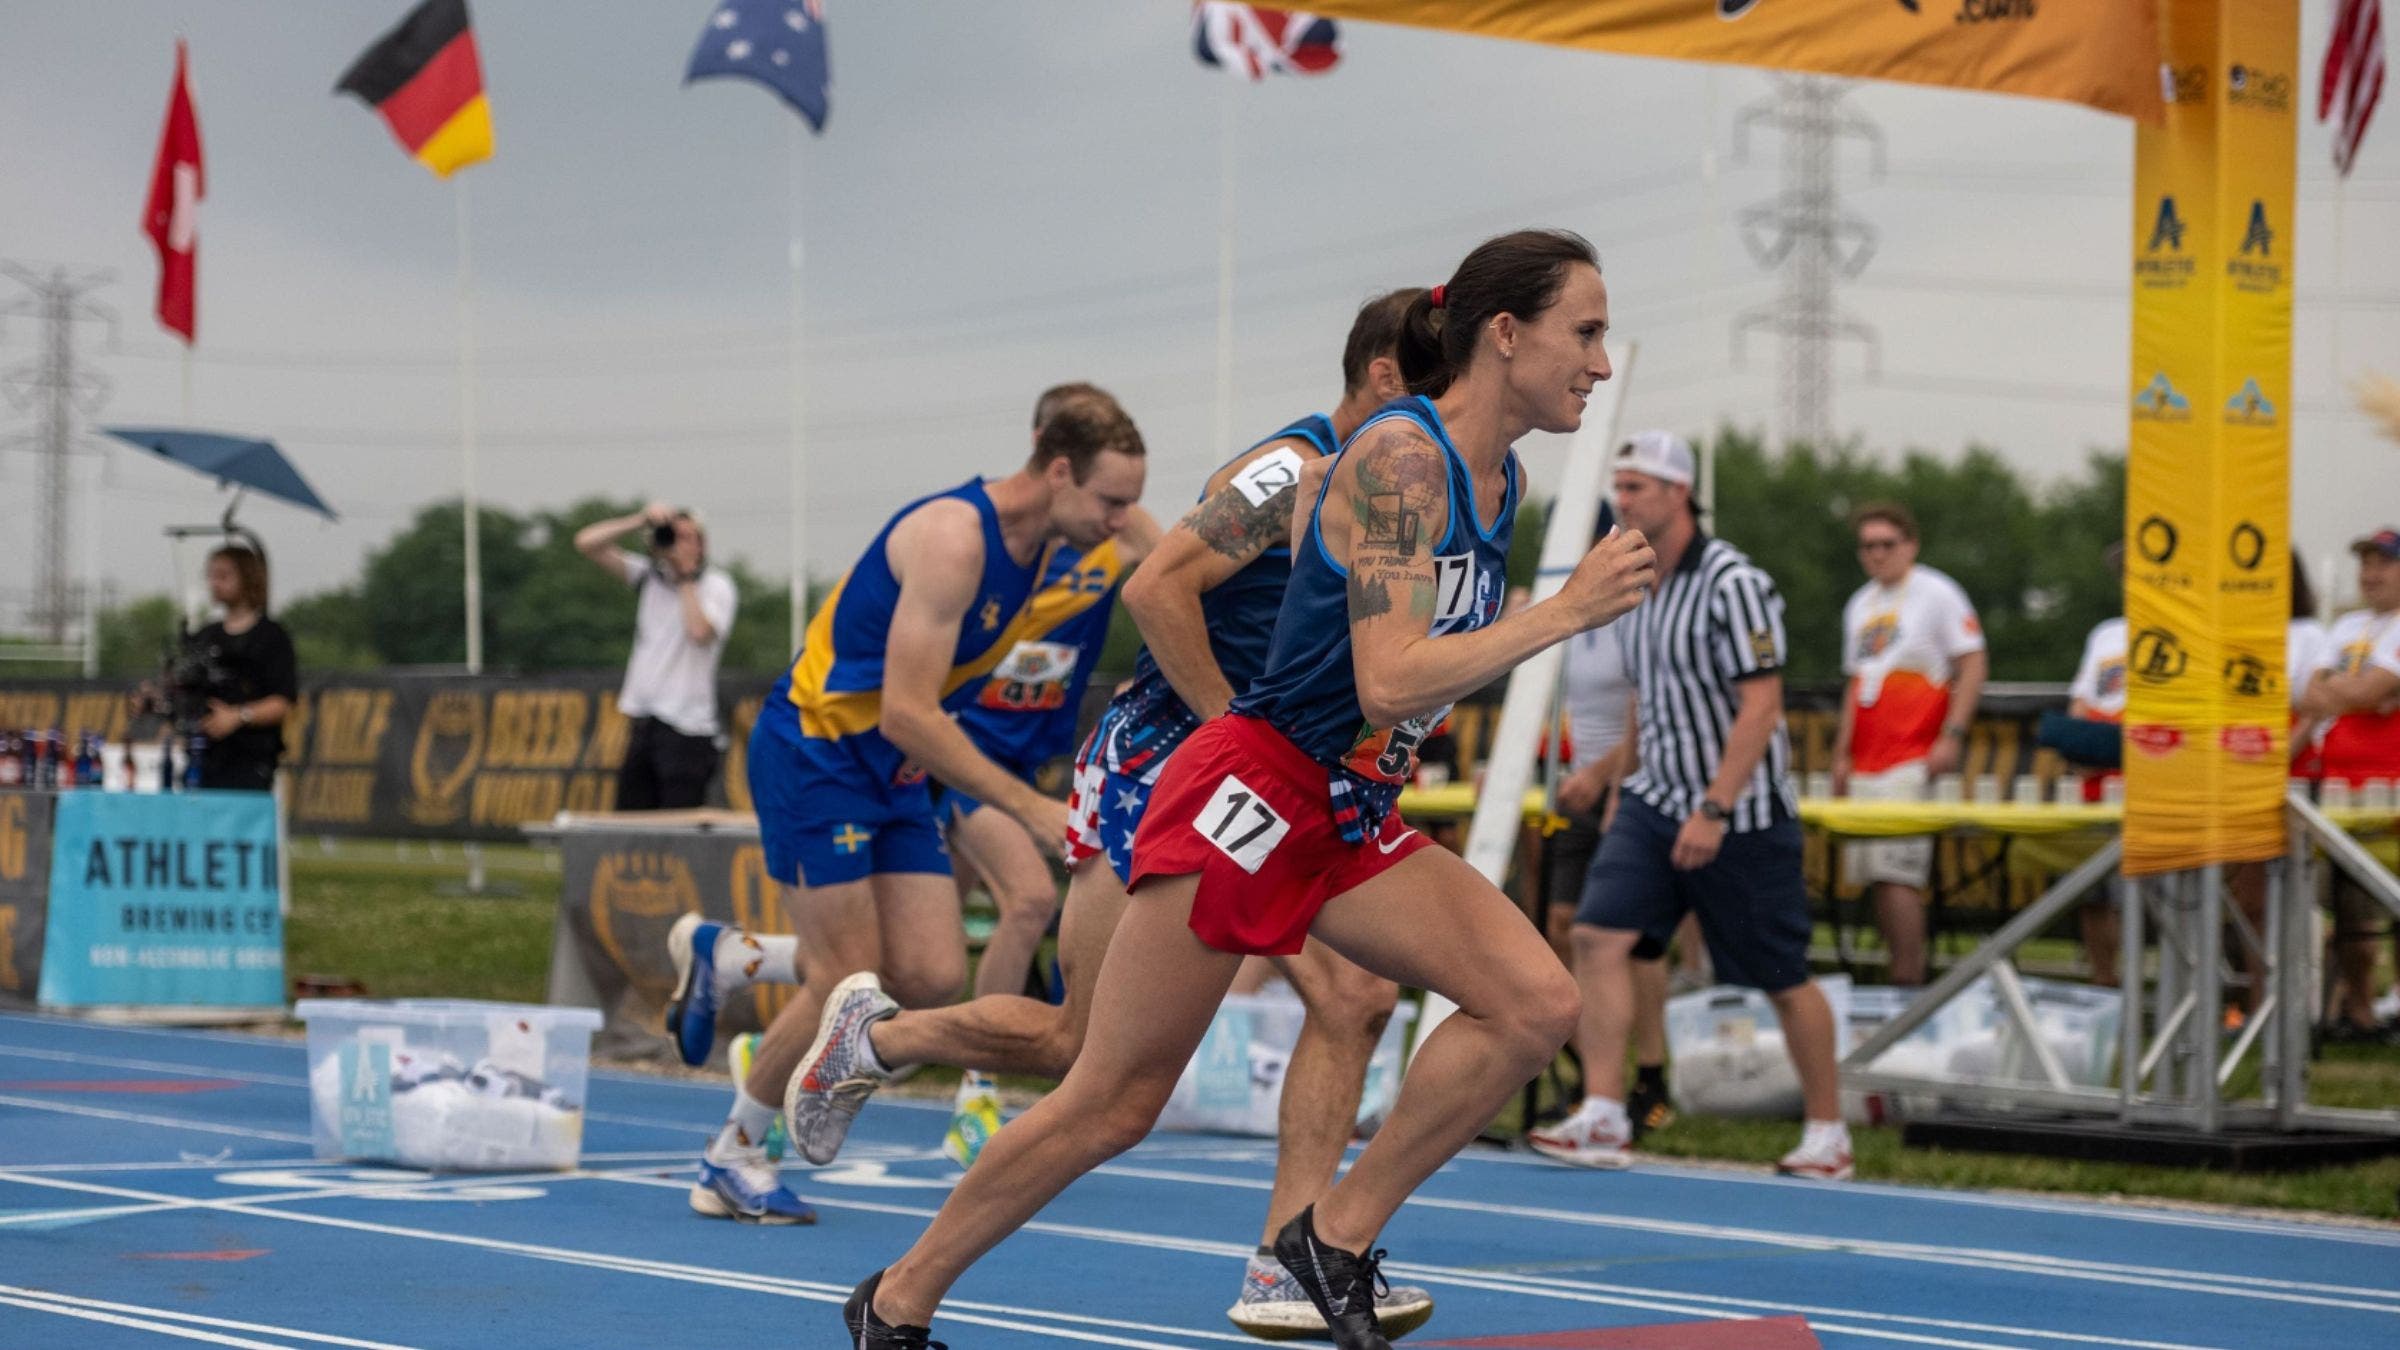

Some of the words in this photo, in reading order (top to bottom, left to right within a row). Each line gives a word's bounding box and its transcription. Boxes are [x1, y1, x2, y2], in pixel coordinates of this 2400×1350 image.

[1248, 460, 1295, 497] 12
[1211, 791, 1277, 854] 17
[121, 905, 234, 934] BREWING
